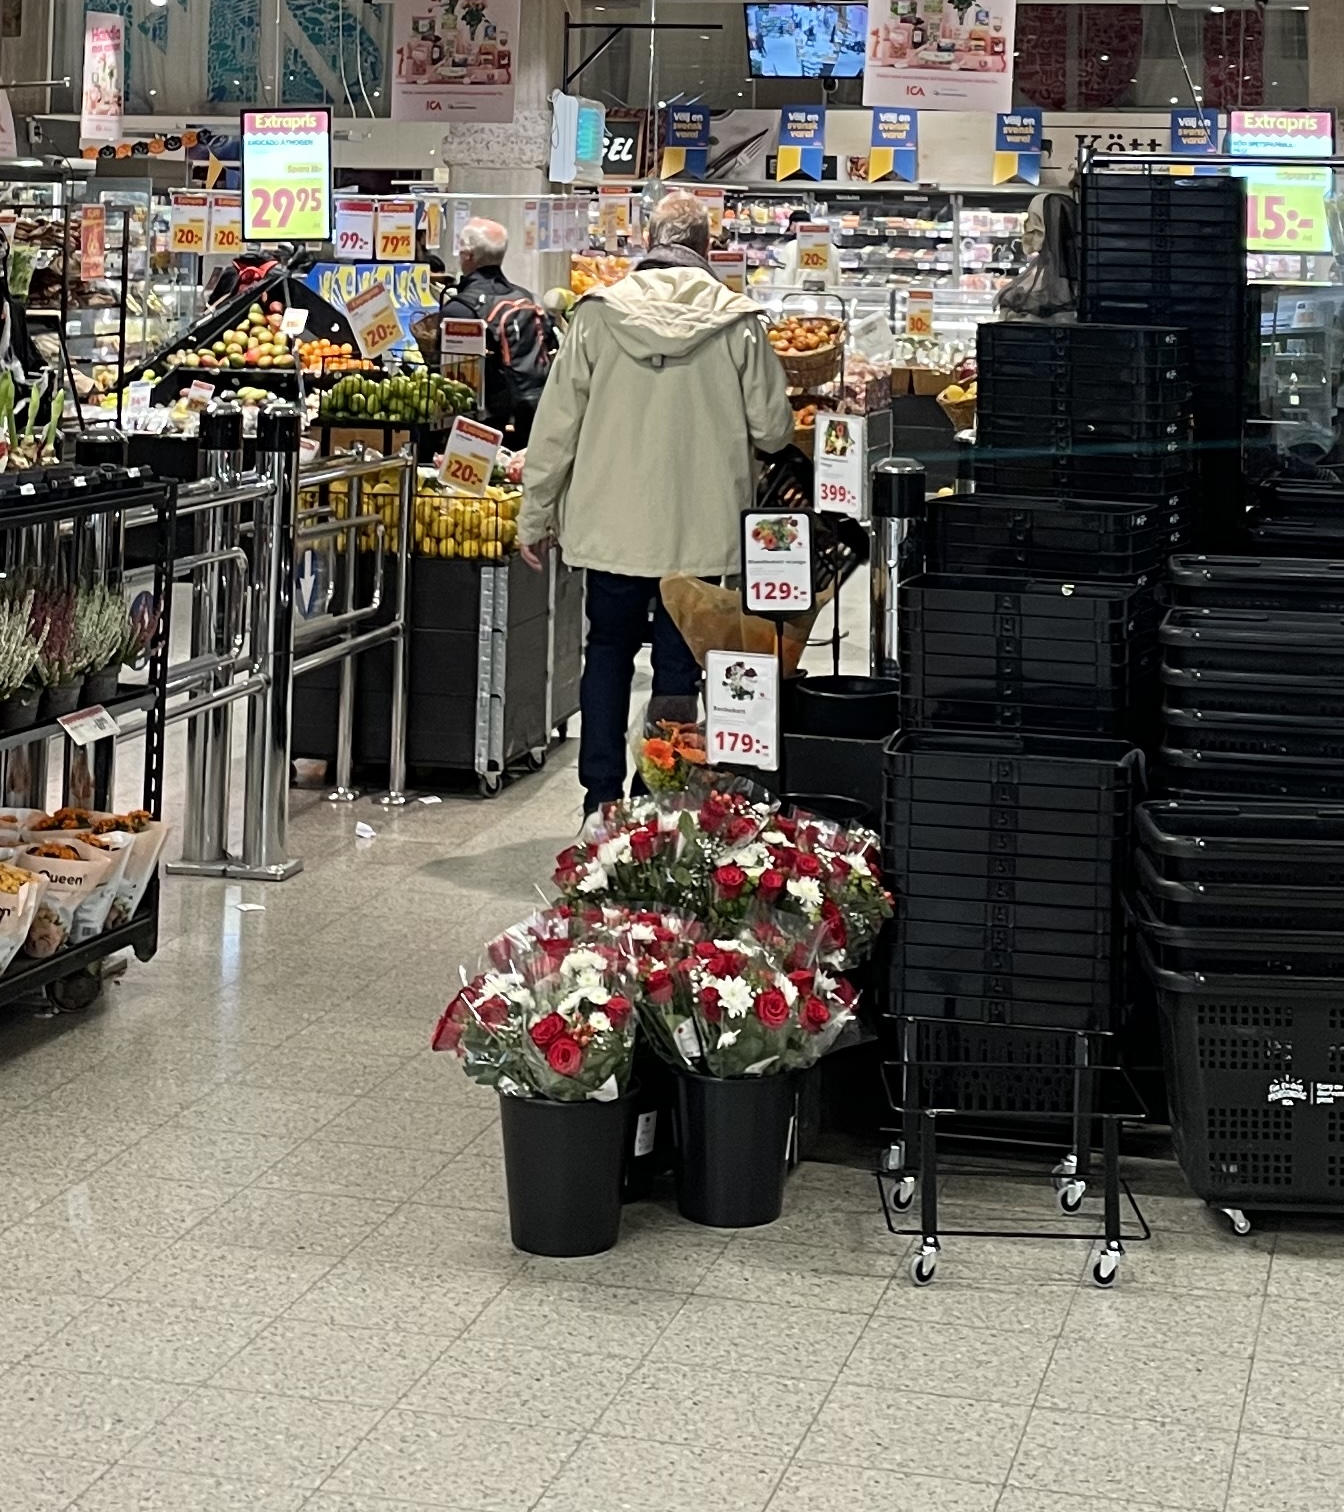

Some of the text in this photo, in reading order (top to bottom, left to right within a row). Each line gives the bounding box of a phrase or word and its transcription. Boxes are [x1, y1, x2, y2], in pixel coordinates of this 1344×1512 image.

[906, 85, 925, 97] ICA
[426, 100, 442, 111] ICA
[255, 113, 317, 131] Extrapris
[1244, 113, 1318, 133] Extrapris
[339, 231, 369, 250] 99:-
[450, 459, 483, 485] 20:-
[820, 482, 856, 502] 399:-
[751, 581, 807, 600] 129:-
[715, 731, 769, 754] 179:-
[39, 869, 83, 886] Queen
